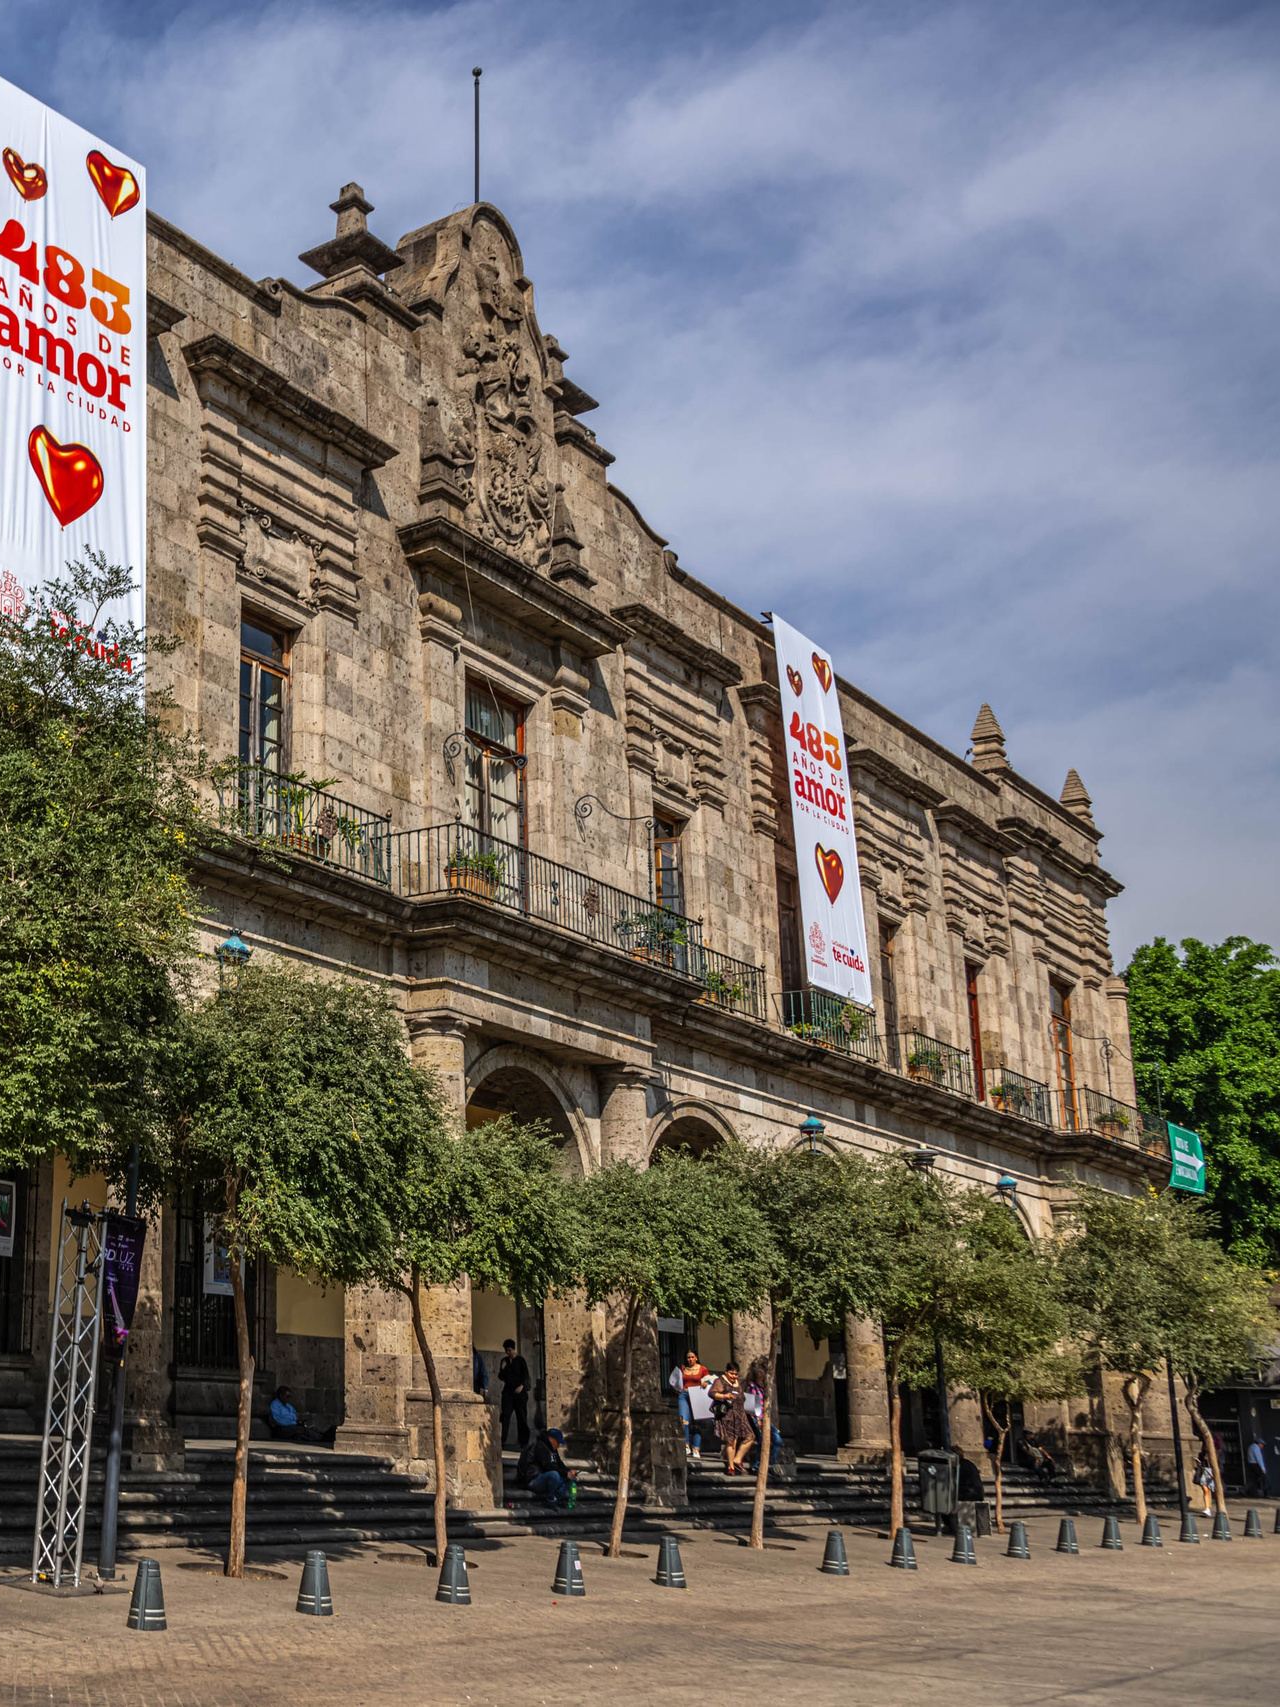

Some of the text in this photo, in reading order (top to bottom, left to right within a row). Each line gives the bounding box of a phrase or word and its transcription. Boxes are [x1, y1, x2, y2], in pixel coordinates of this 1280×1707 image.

[99, 333, 130, 366] DE
[37, 374, 55, 393] LA
[67, 391, 131, 433] CIUDAD
[789, 711, 842, 771] 483
[793, 751, 844, 791] AÑOS DE
[794, 769, 846, 821] amor
[796, 801, 849, 835] POR LA CIUDAD
[832, 946, 842, 963] te
[842, 953, 865, 973] cuida
